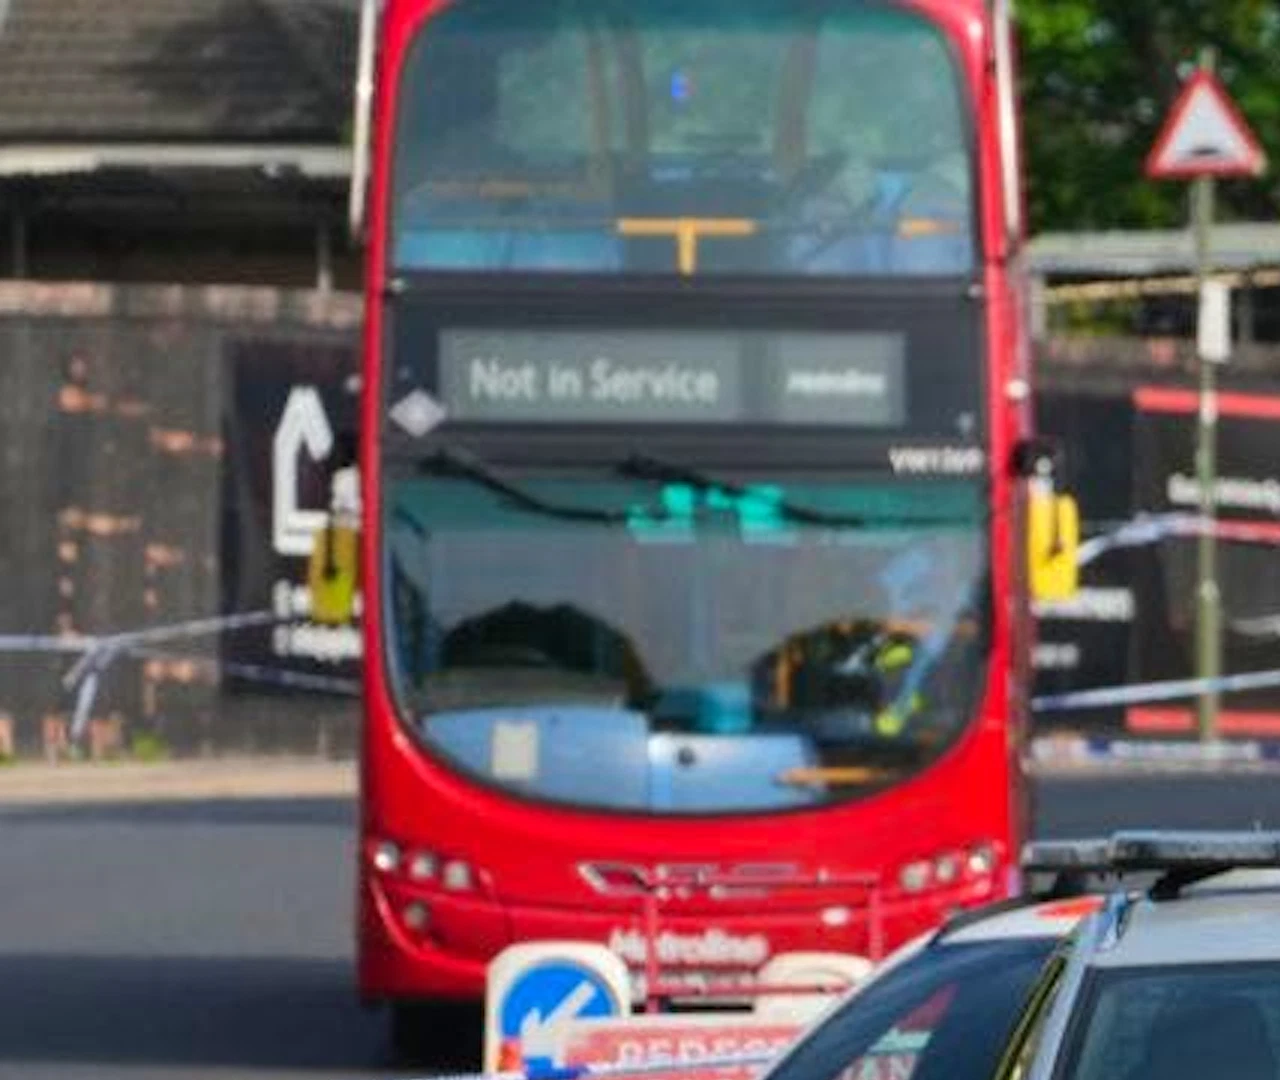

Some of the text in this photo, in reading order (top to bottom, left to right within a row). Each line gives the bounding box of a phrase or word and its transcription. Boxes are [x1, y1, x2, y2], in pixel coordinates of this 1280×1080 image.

[470, 357, 717, 402] Not in Service
